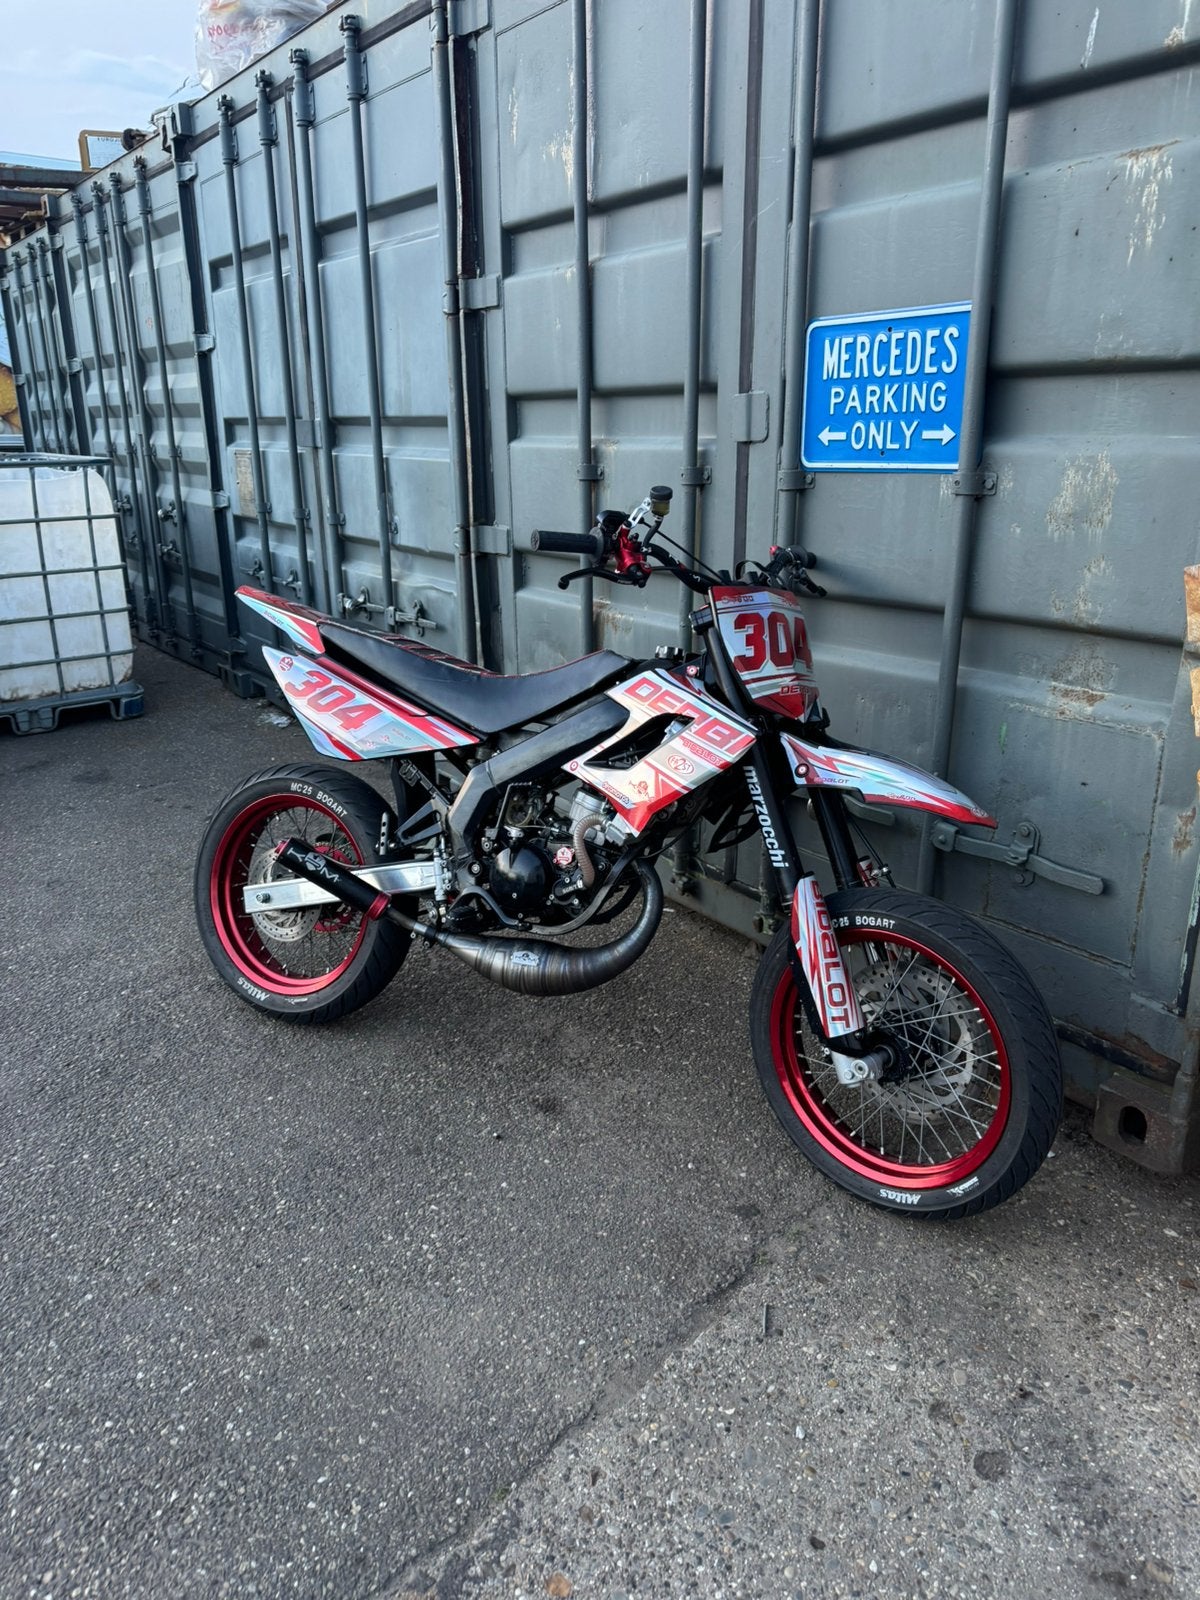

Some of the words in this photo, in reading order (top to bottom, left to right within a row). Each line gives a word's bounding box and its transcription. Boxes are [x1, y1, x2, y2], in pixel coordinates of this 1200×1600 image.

[823, 326, 960, 380] MERCEDES
[830, 381, 948, 415] PARKING
[851, 420, 920, 450] ONLY
[284, 670, 383, 732] 304
[623, 676, 757, 756] DERBI
[316, 790, 349, 818] BOGART
[742, 765, 790, 868] marzocchi
[831, 916, 850, 929] C25
[855, 915, 896, 929] BOGART
